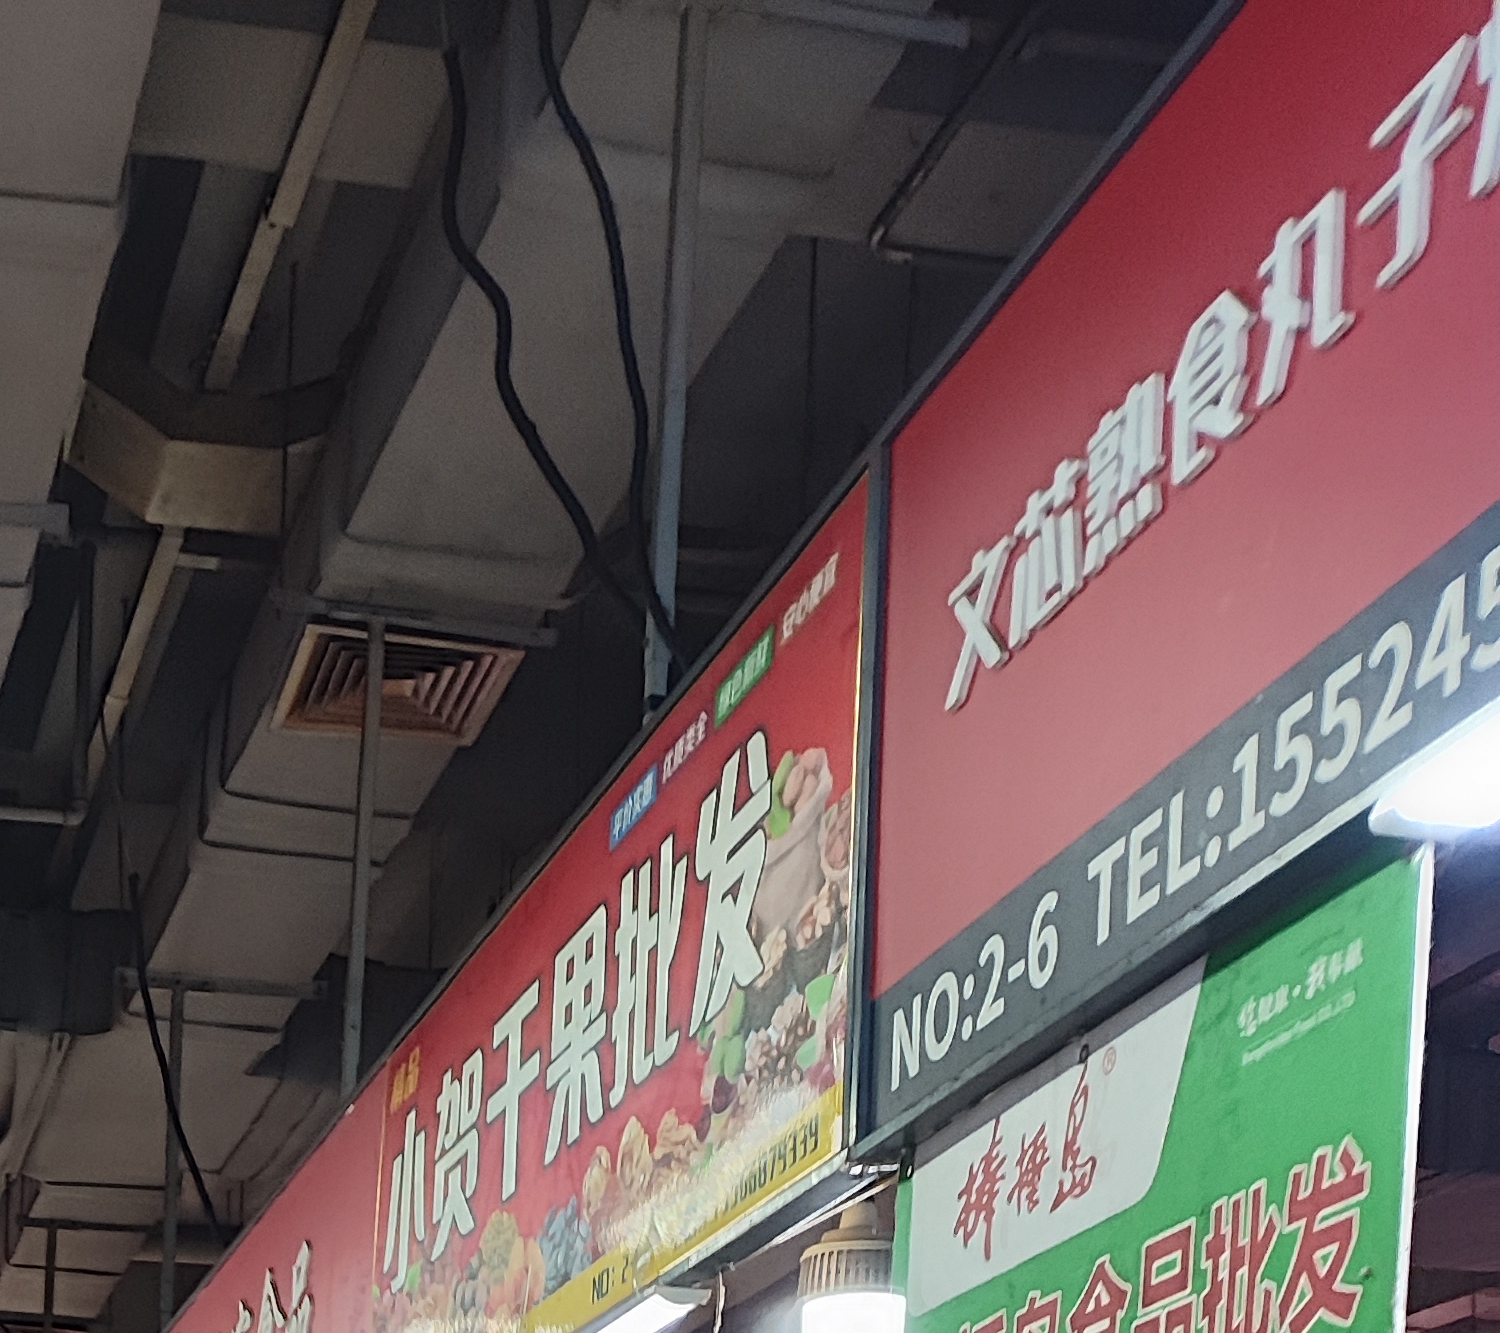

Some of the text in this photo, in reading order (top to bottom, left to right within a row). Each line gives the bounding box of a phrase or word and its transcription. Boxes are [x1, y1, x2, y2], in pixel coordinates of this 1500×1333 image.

[944, 0, 1500, 712] 文芯熟食丸子
[382, 730, 771, 1294] 小贺干果批发
[890, 890, 1060, 1093] NO:2-6
